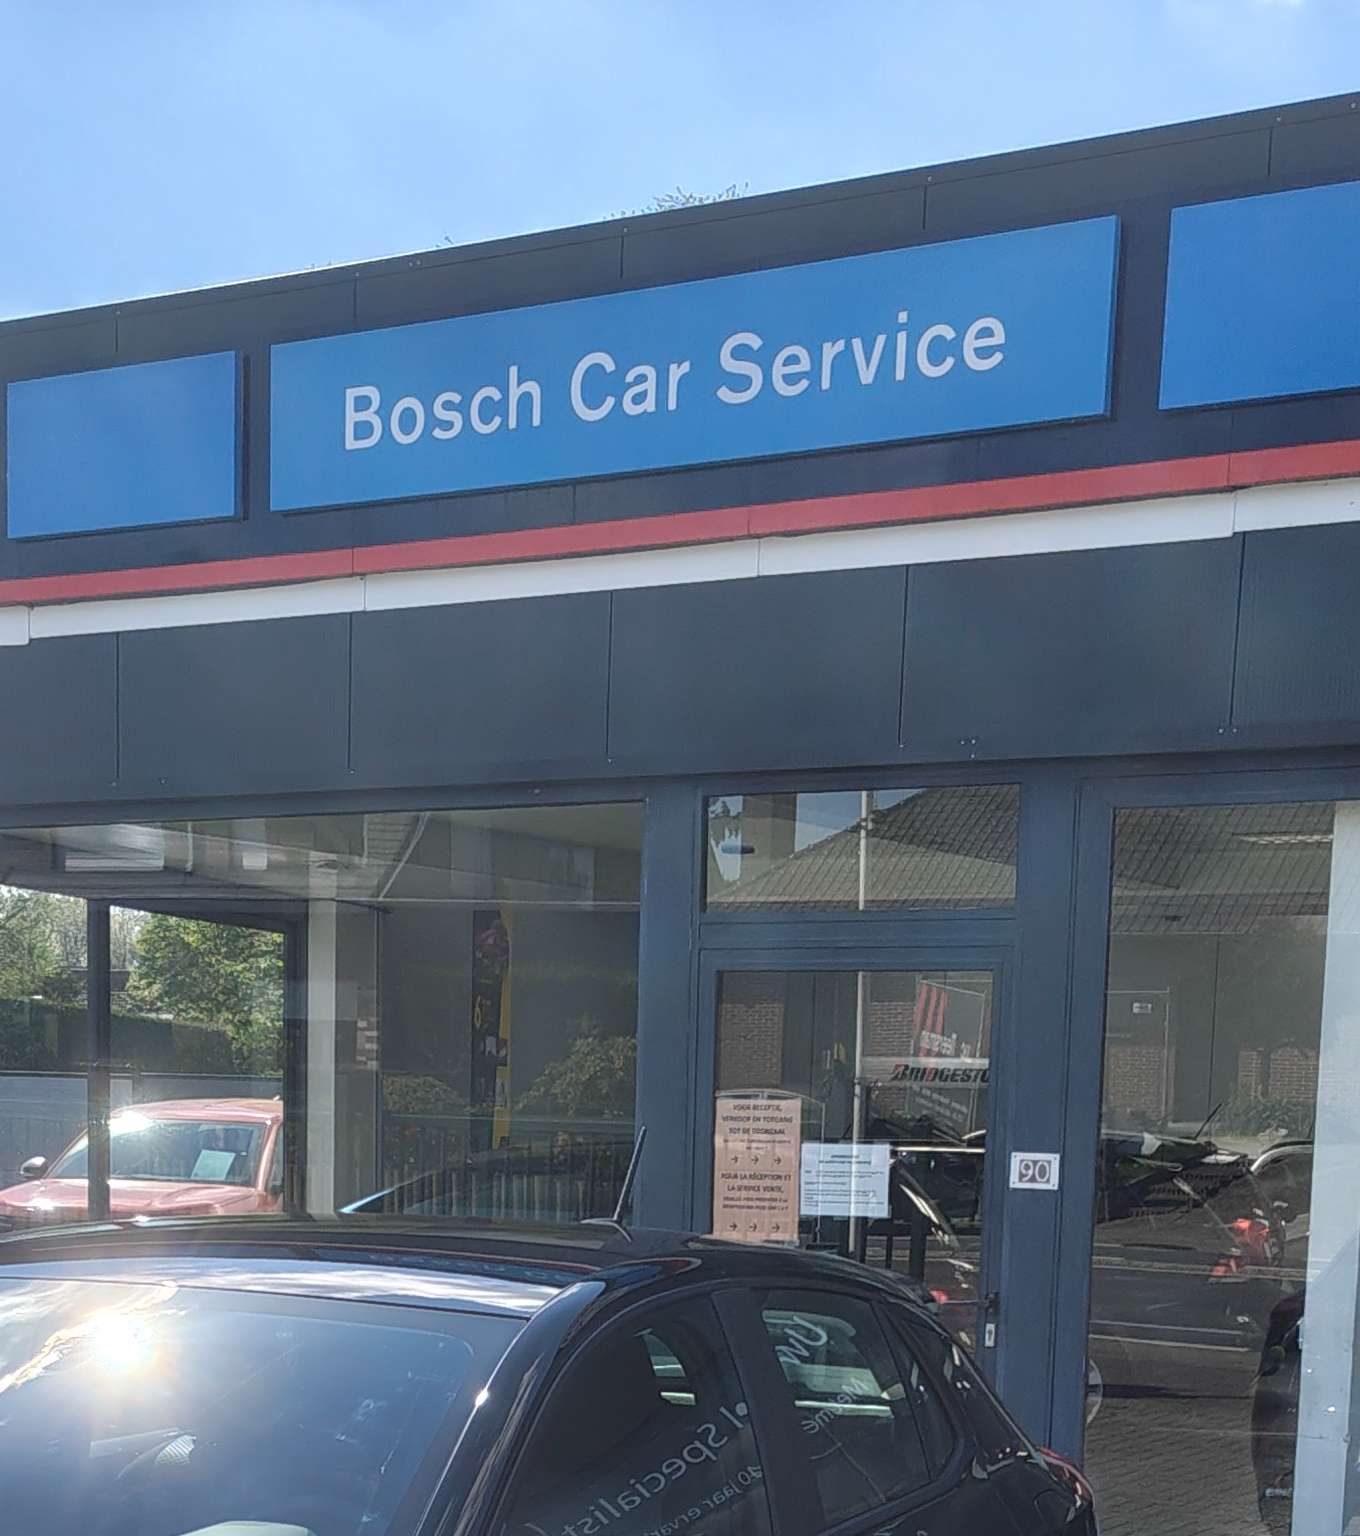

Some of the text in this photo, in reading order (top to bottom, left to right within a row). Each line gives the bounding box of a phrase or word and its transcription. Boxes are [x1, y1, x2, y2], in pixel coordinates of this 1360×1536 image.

[344, 310, 1006, 451] Bosch Car Service
[1020, 1160, 1049, 1182] 90
